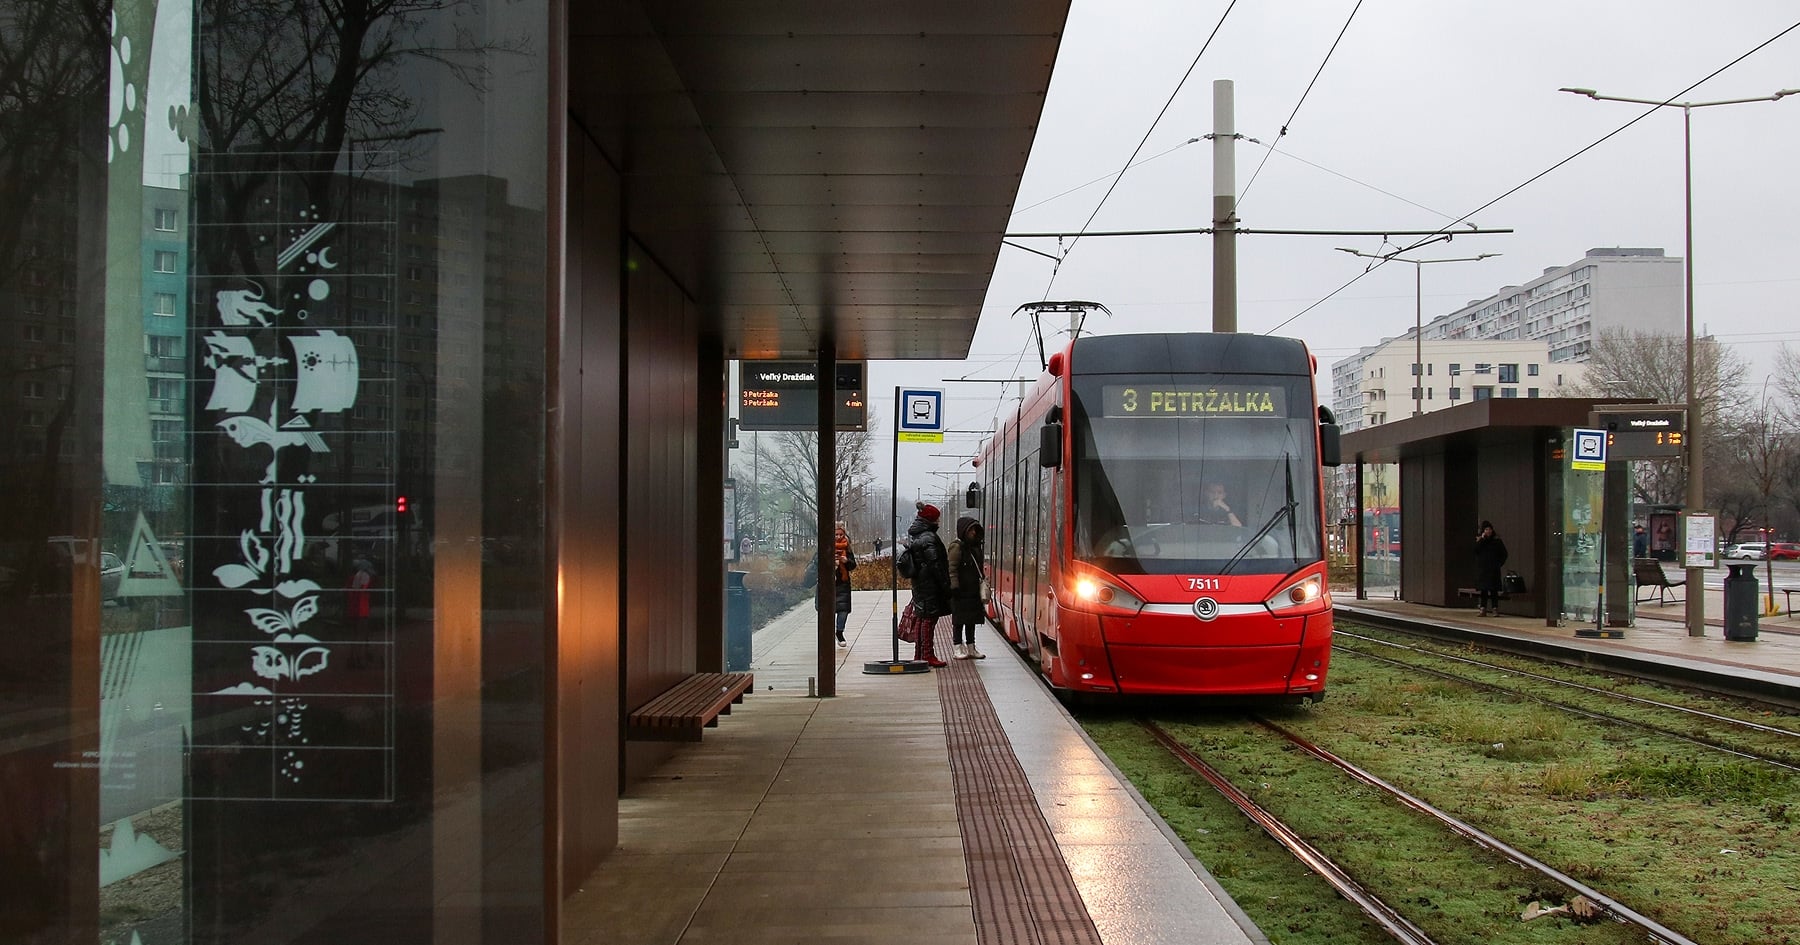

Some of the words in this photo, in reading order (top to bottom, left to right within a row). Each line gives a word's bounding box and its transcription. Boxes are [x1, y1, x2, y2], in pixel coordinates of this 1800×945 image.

[1122, 388, 1138, 412] 3
[1150, 388, 1274, 412] PETRŽALKA
[1187, 578, 1219, 590] 7511
